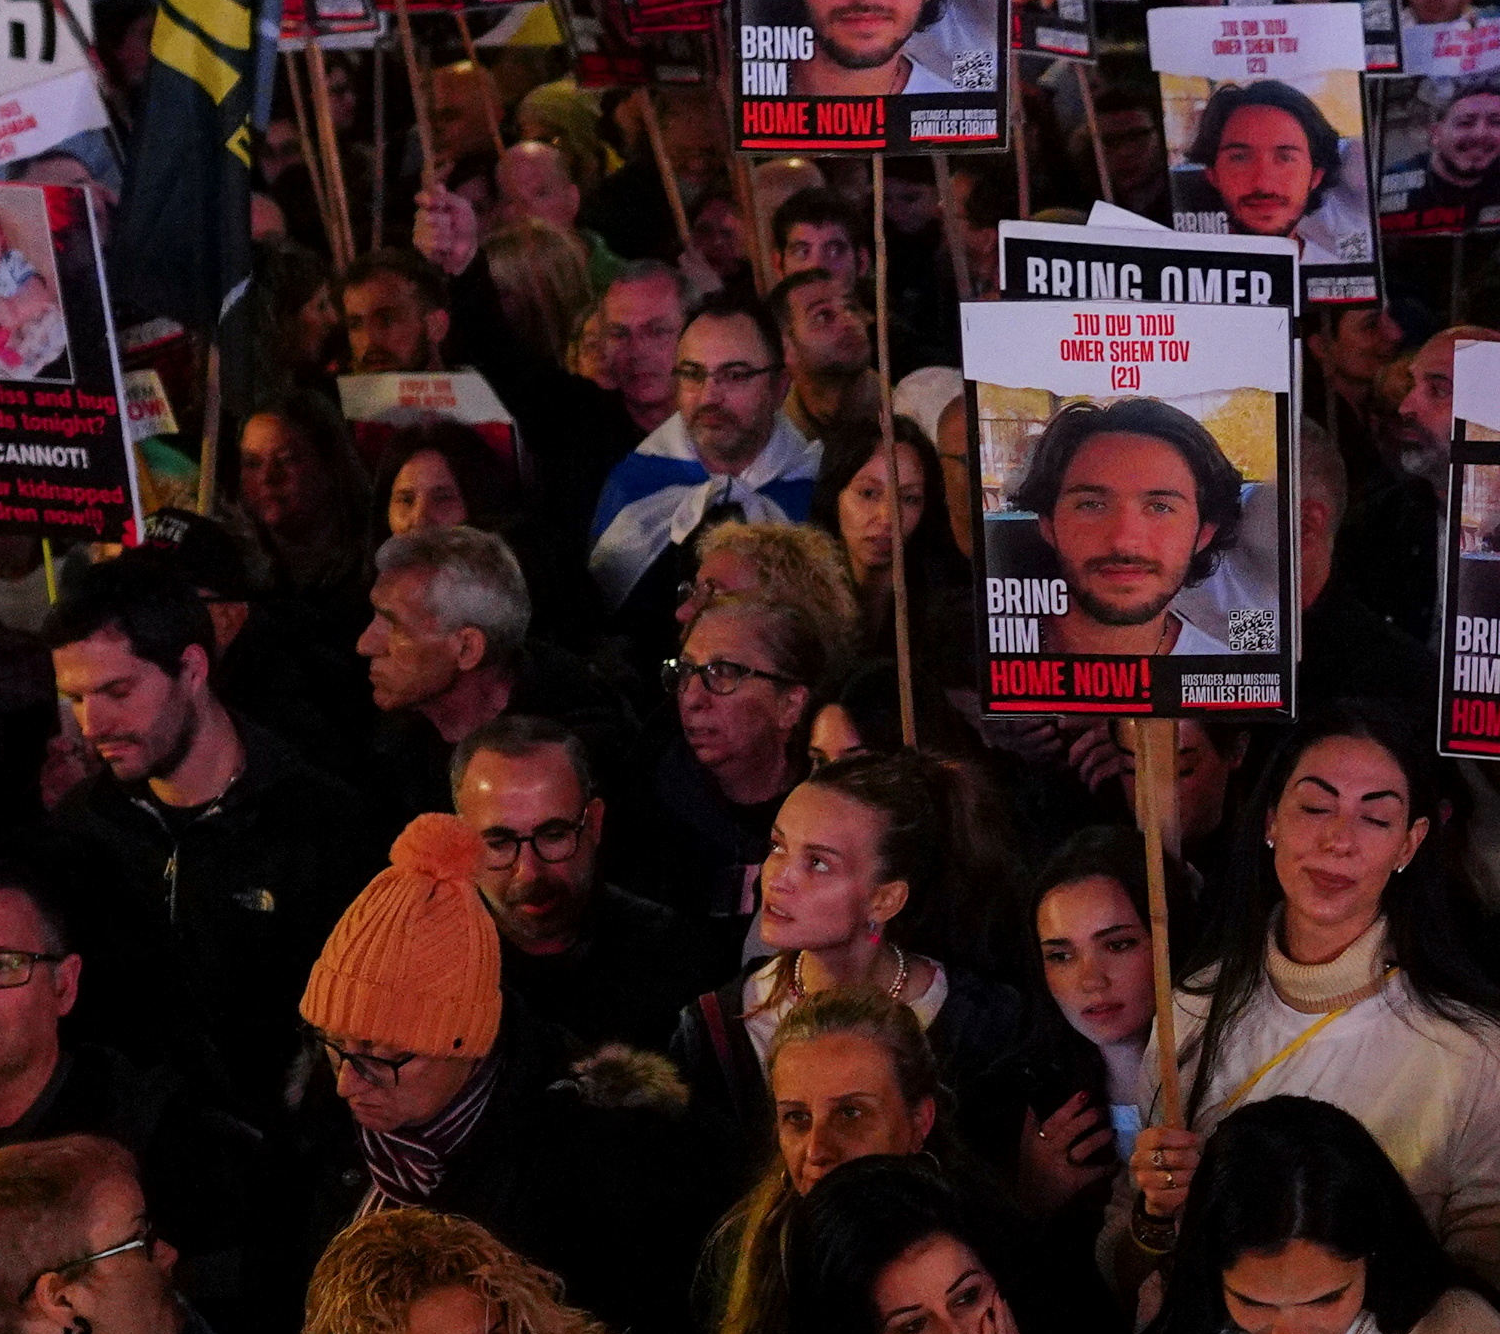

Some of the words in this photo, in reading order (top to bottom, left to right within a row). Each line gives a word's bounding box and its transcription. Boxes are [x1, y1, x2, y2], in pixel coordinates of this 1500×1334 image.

[741, 25, 813, 60] BRING
[742, 61, 787, 95] HIM
[743, 102, 809, 134] HOME
[817, 98, 885, 135] NOW!
[1074, 314, 1100, 336] טוב
[1106, 315, 1131, 336] שם
[1136, 315, 1174, 336] עומר
[1061, 340, 1104, 362] OMER
[1110, 341, 1154, 362] SHEM
[1159, 341, 1189, 362] TOV
[1111, 365, 1140, 390] (21)
[34, 390, 72, 408] and
[77, 390, 117, 415] hug
[21, 414, 106, 437] tonight?
[17, 479, 124, 510] kidnapped
[987, 578, 1067, 615] BRING
[989, 616, 1039, 653] HIM
[991, 660, 1065, 695] HOME
[1074, 659, 1150, 698] NOW!
[1181, 674, 1227, 690] HOSTAGES
[1225, 674, 1242, 685] AND
[1240, 674, 1280, 690] MISSING
[1454, 655, 1500, 694] HIM
[1182, 683, 1235, 703] FAMILIES
[1238, 683, 1280, 703] FORUM
